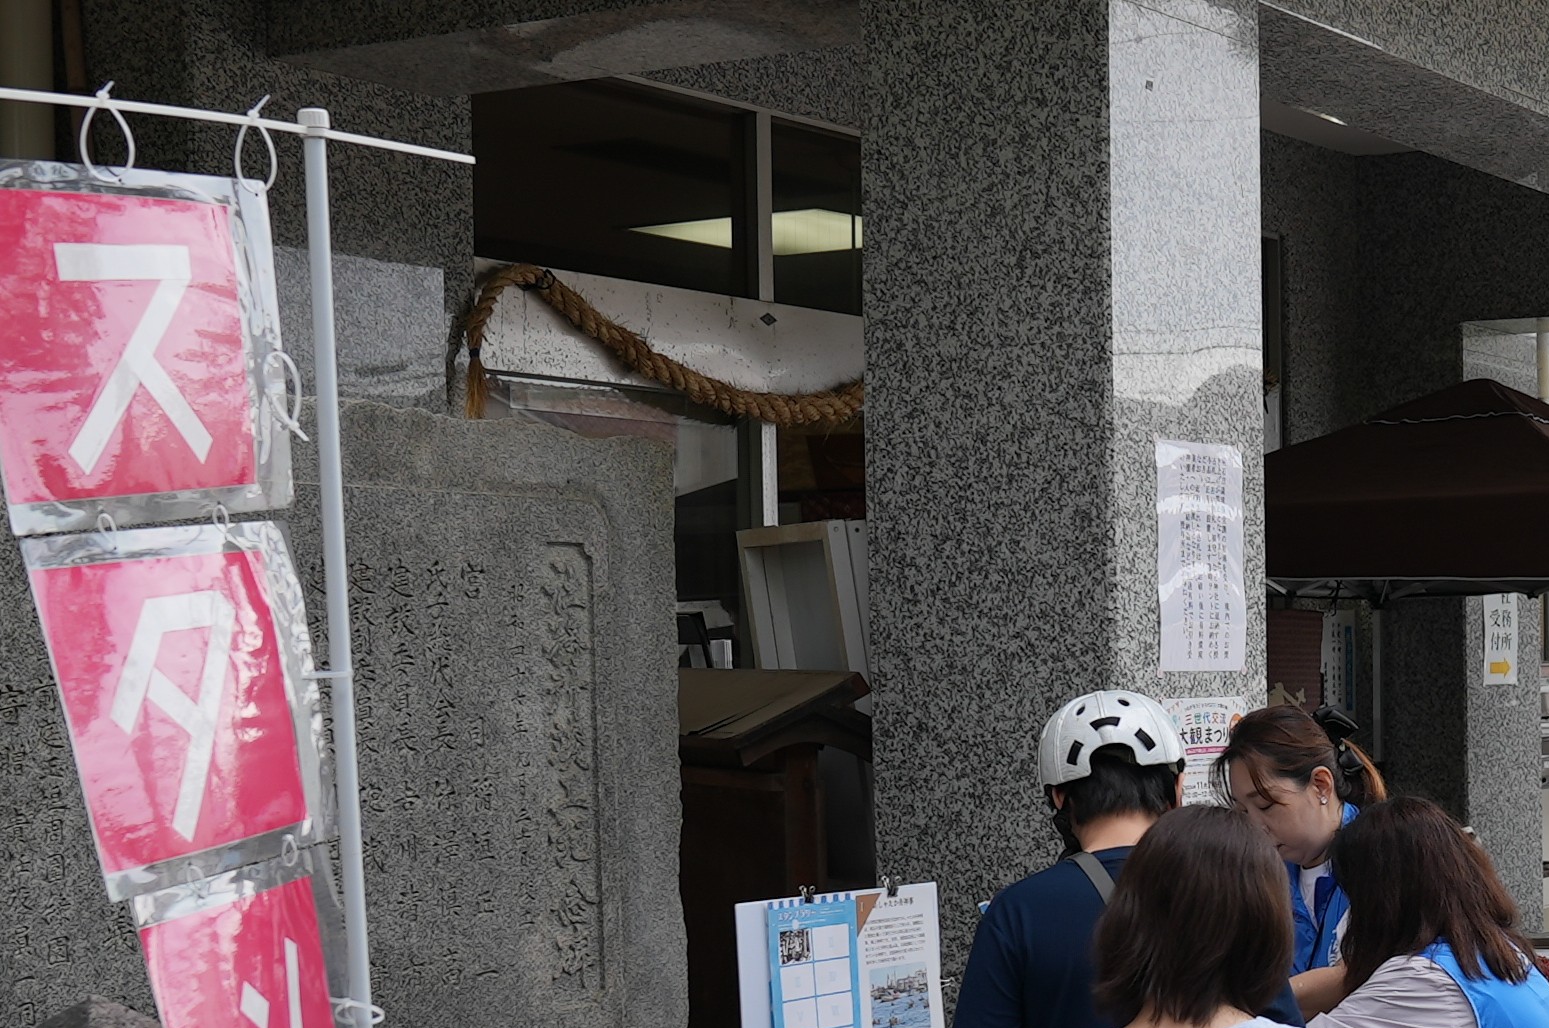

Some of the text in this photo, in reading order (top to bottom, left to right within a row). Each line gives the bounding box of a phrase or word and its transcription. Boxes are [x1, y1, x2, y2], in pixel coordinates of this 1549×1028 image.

[1179, 726, 1230, 745] 大観まつり
